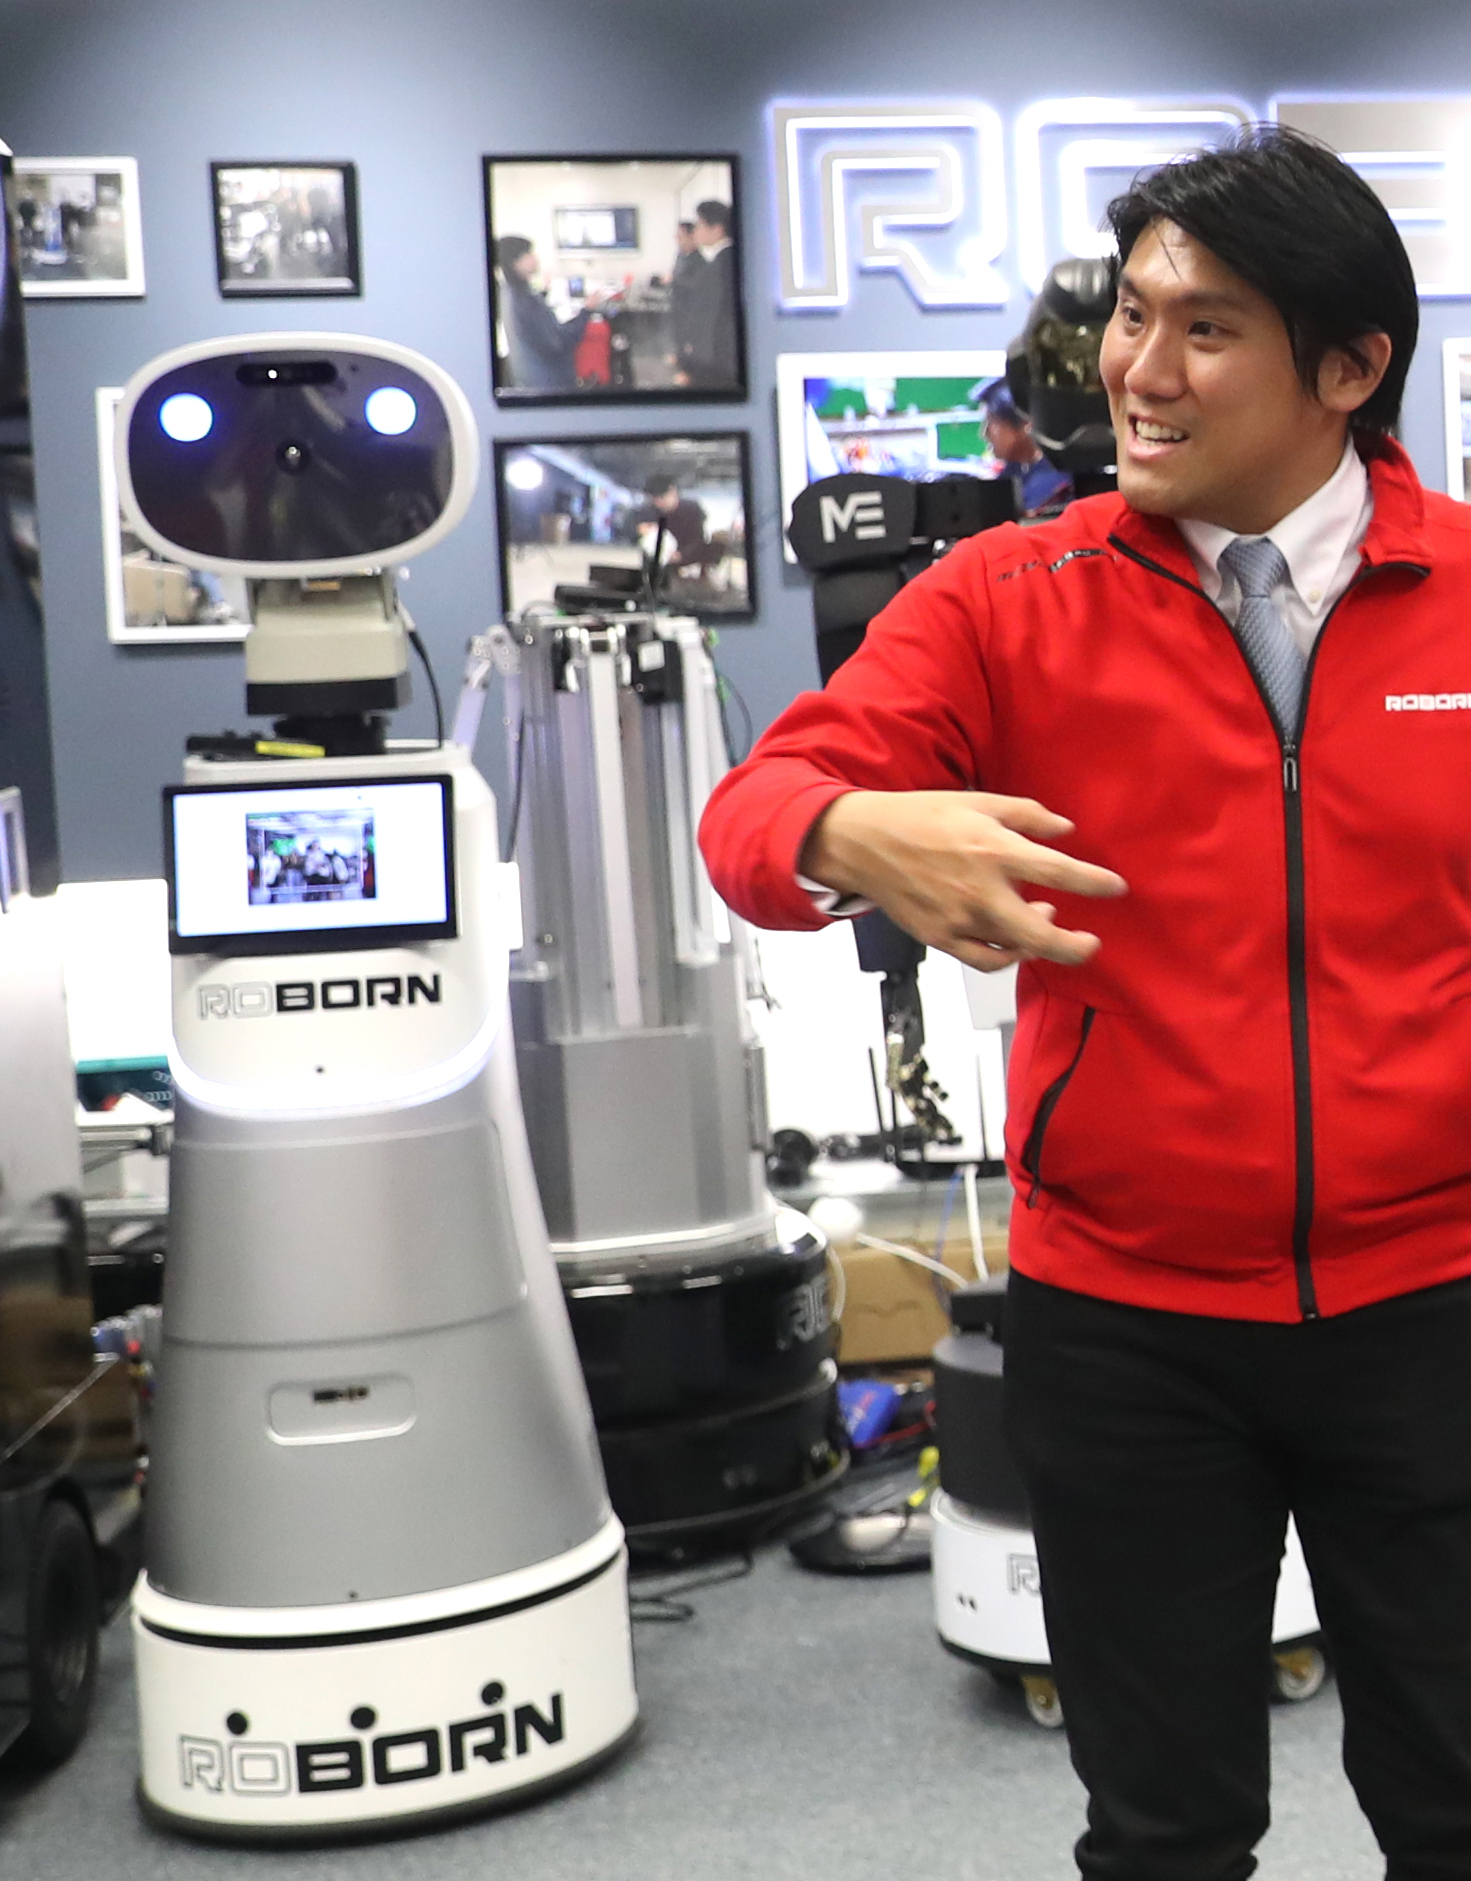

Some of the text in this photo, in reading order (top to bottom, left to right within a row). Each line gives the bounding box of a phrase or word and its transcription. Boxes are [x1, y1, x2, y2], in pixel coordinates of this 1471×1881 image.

[819, 490, 886, 543] ME
[197, 974, 441, 1020] ROBORN
[179, 1692, 564, 1795] ROBORN
